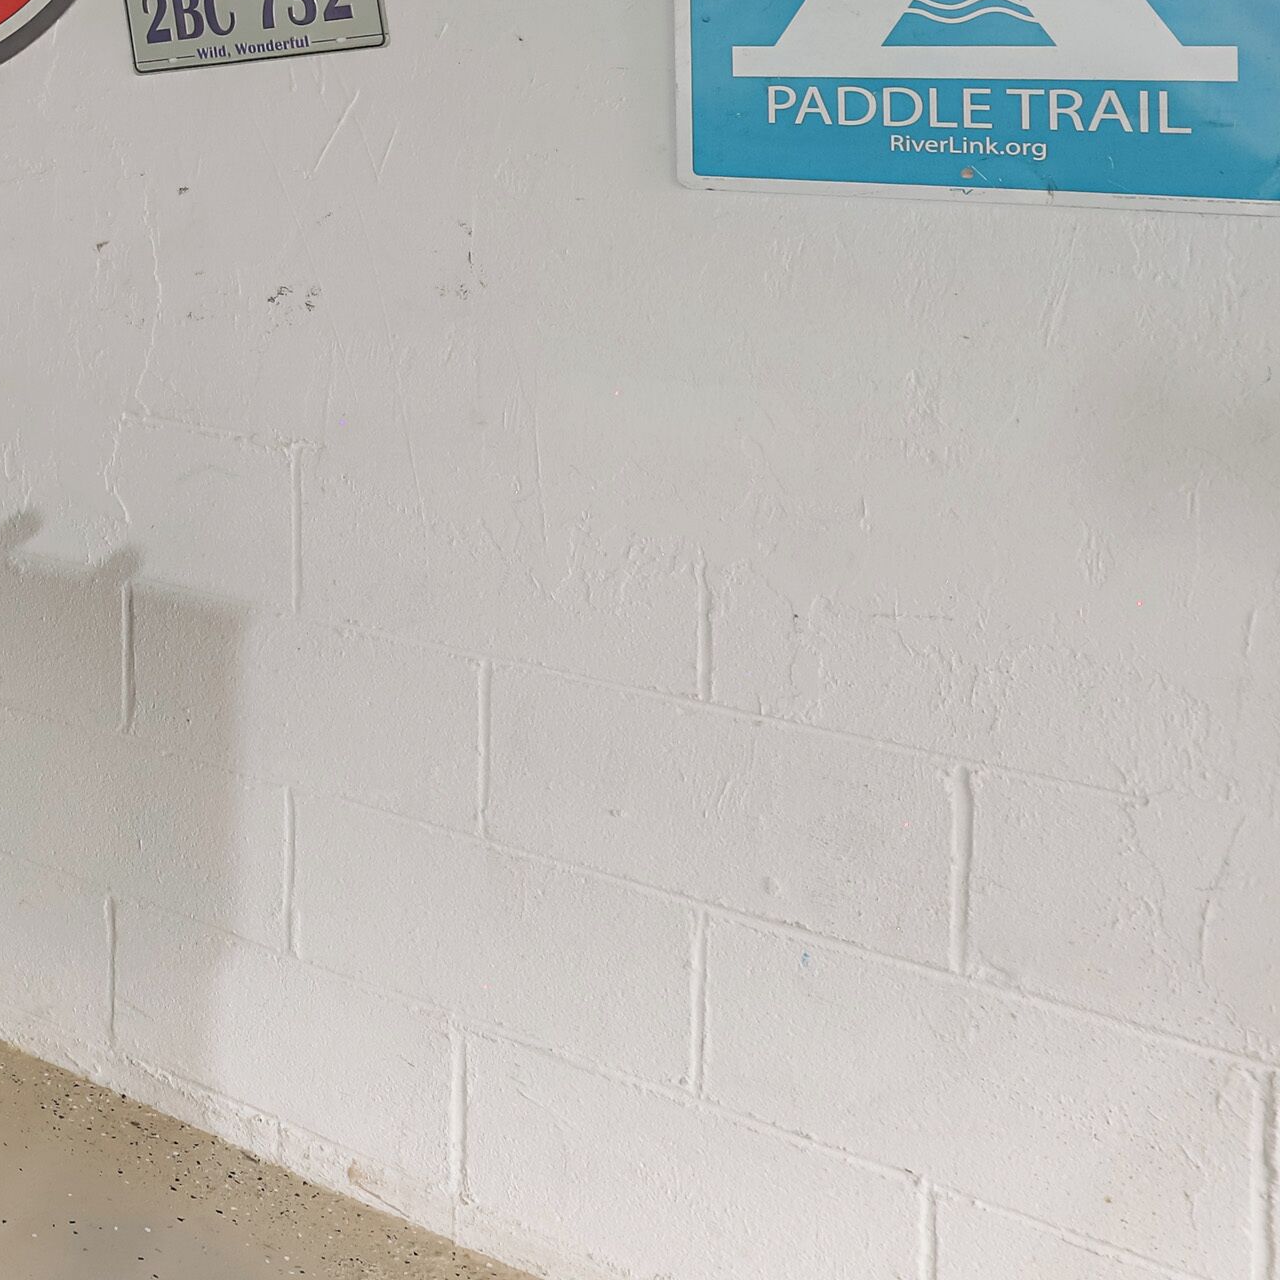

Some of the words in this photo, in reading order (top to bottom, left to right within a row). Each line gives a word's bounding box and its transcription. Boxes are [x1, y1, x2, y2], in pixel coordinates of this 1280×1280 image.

[196, 43, 232, 61] Wild,
[235, 35, 310, 56] Wonderful
[766, 84, 994, 131] PADDLE
[1006, 88, 1193, 135] TRAIL
[889, 133, 1049, 161] RiverLink.org
